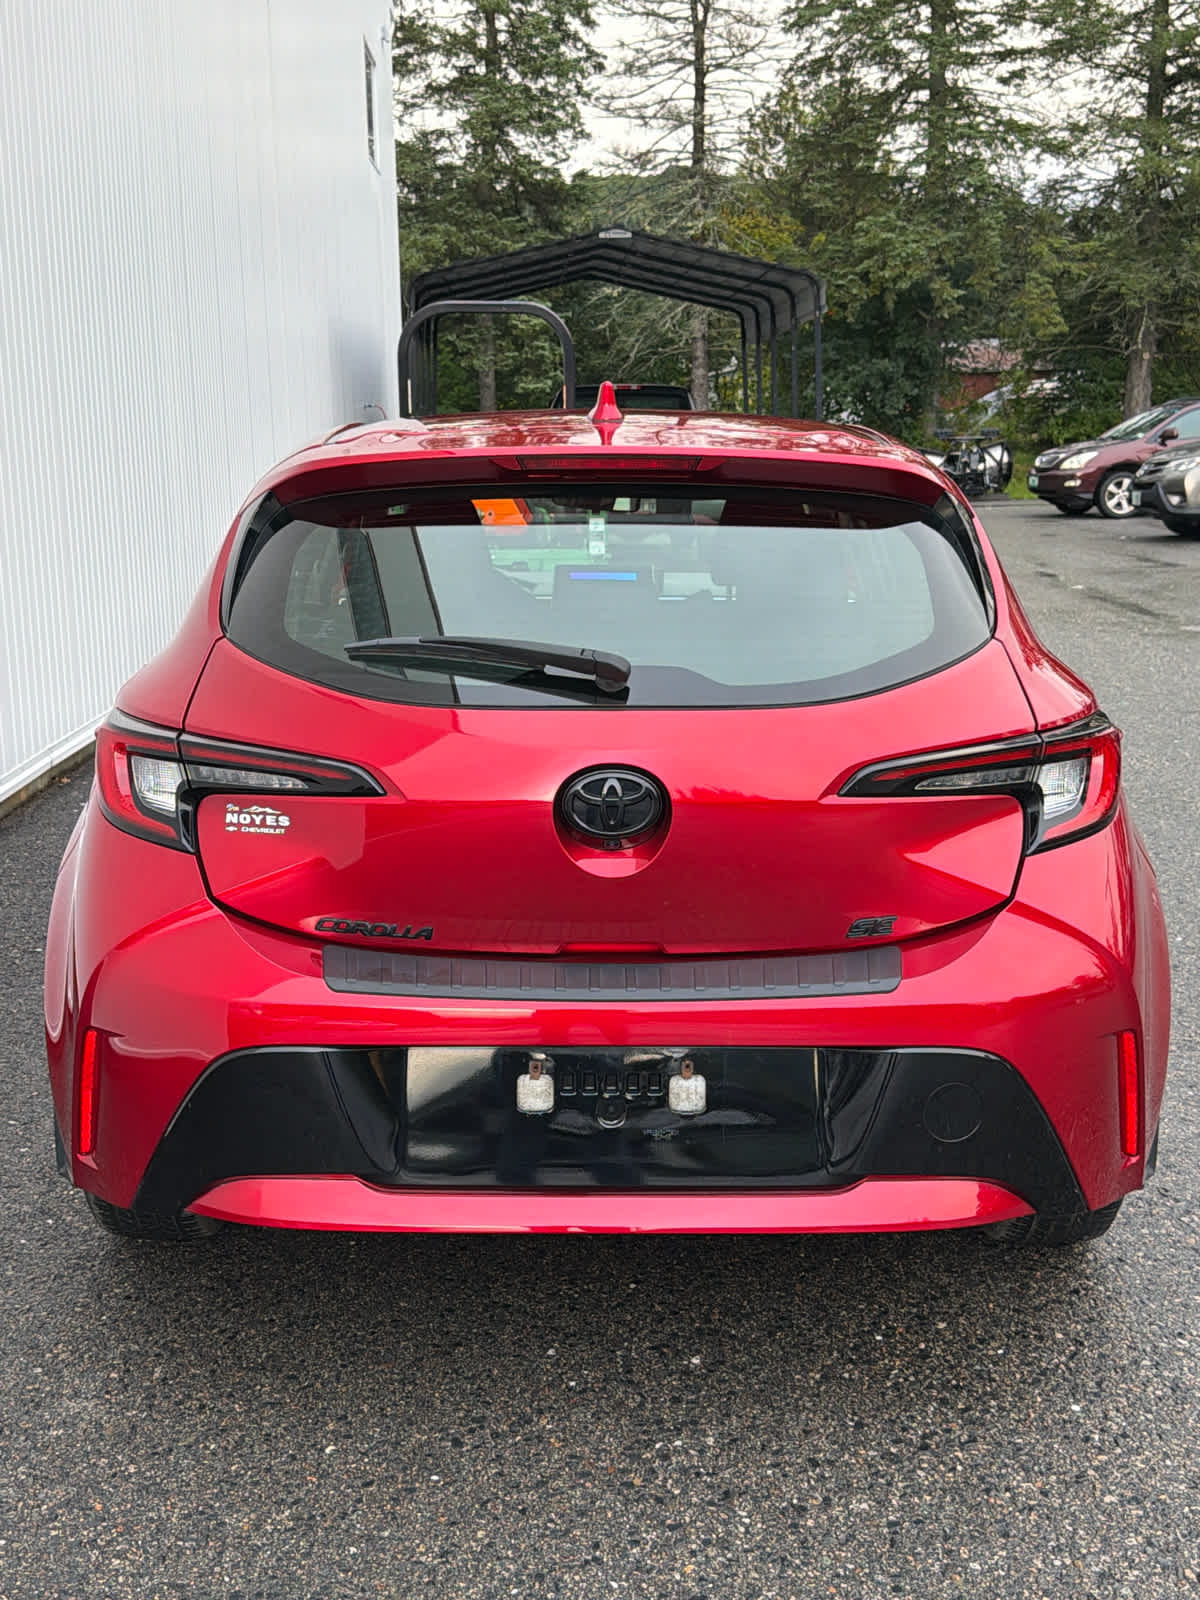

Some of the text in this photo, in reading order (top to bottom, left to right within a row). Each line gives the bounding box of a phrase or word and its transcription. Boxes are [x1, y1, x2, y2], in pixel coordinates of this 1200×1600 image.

[225, 812, 290, 827] NOYES
[241, 826, 285, 834] CHEVROLET
[315, 917, 434, 941] COROLLA
[846, 915, 898, 939] SE
